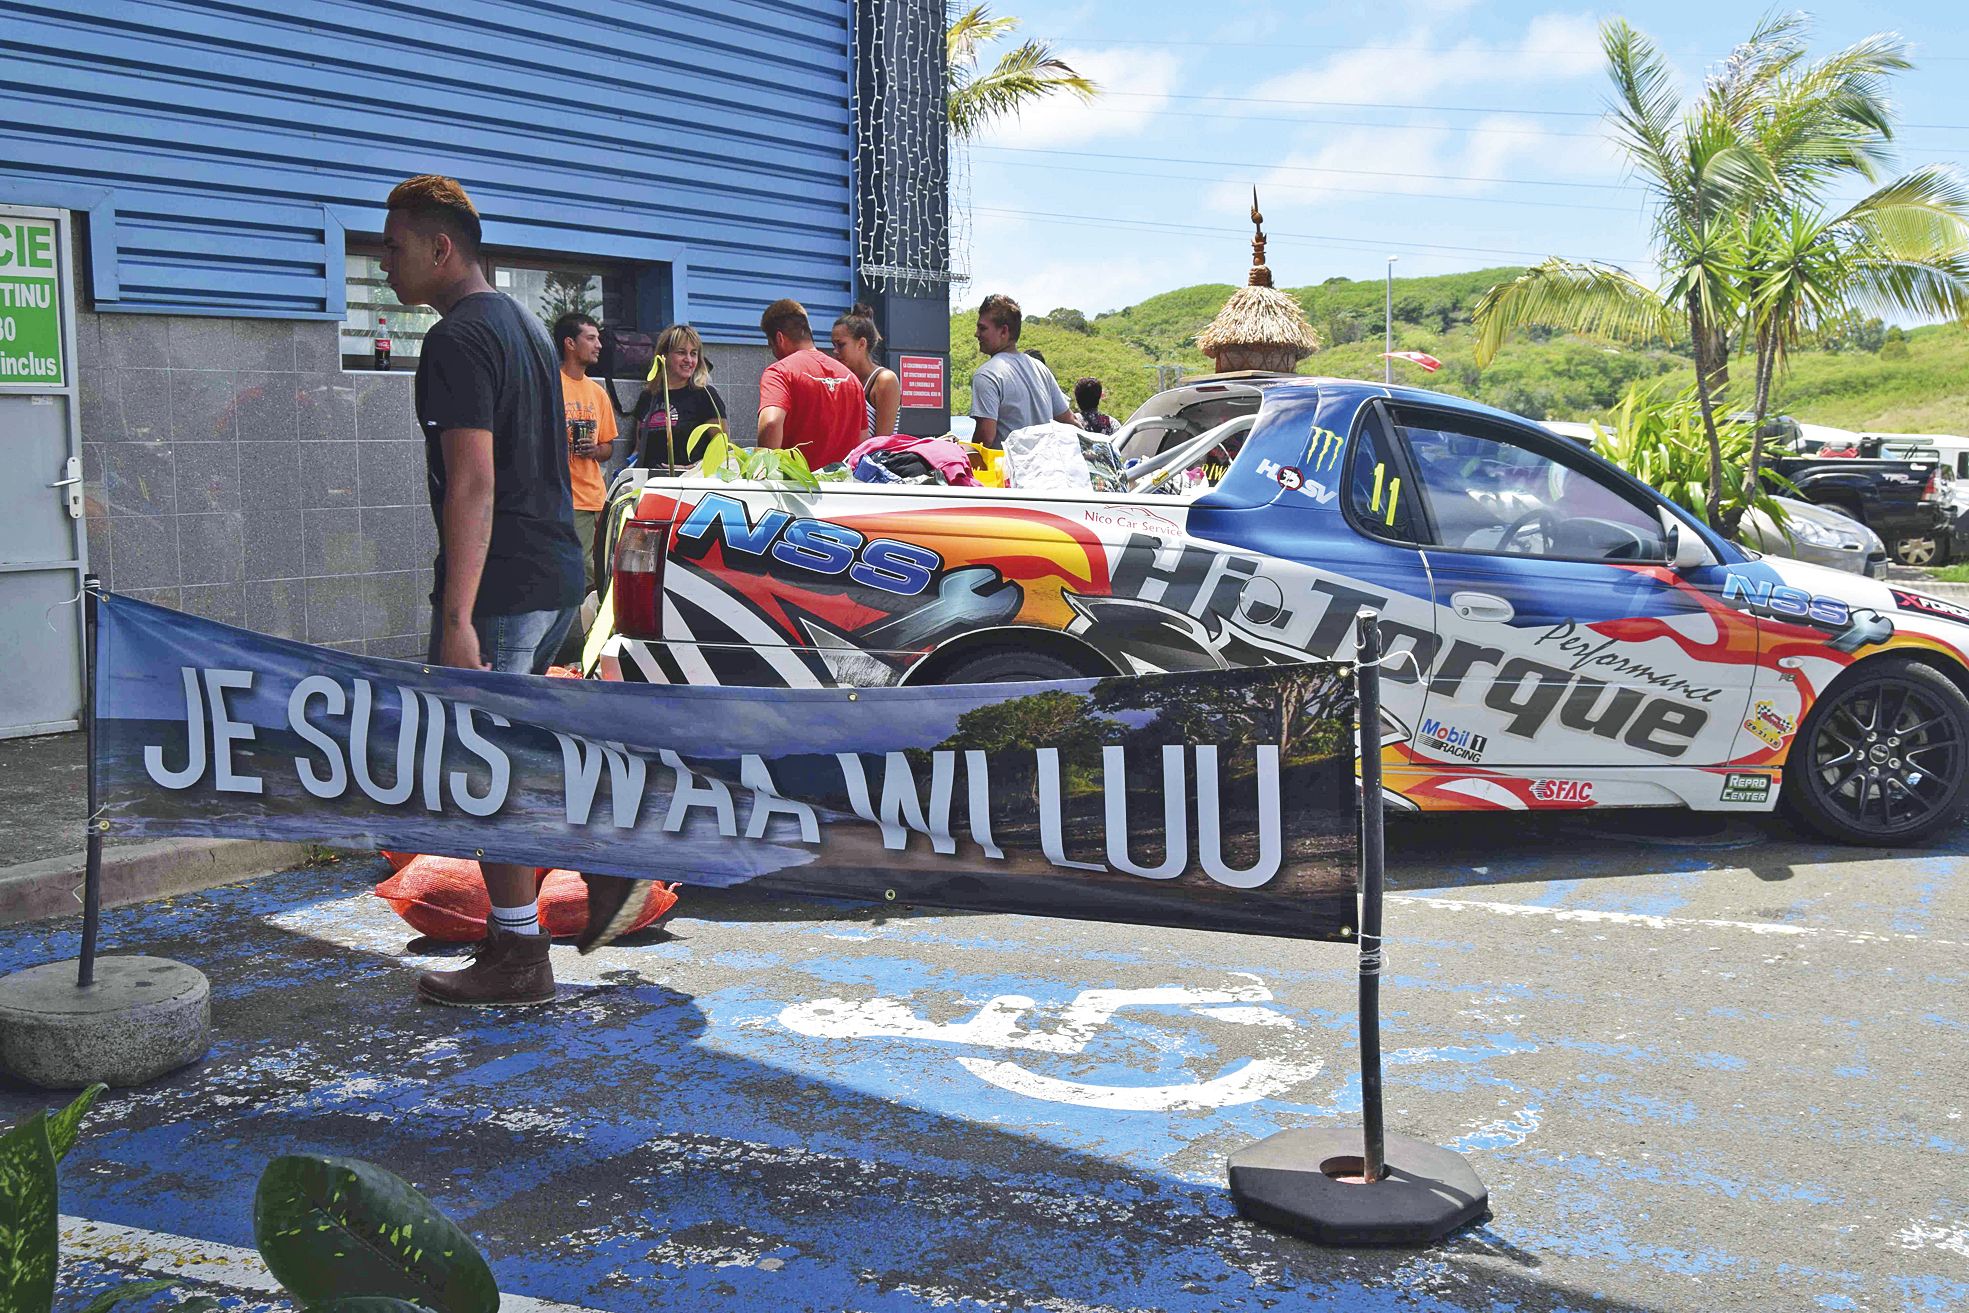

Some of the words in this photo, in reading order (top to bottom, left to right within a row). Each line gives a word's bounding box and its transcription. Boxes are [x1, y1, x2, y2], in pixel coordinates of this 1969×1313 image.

[1, 351, 57, 376] inclus
[1371, 463, 1400, 526] 11
[1085, 510, 1112, 525] Nico
[1116, 517, 1138, 529] Car
[1142, 521, 1183, 537] Service
[678, 492, 941, 595] NSS
[1721, 573, 1849, 626] NSS
[1533, 618, 1722, 703] Performance
[1421, 719, 1470, 747] Mobil
[1440, 741, 1482, 763] RACING
[144, 666, 263, 795] JE
[287, 674, 512, 818] SUIS
[835, 749, 1004, 860] WI
[1036, 744, 1282, 889] LUU
[1543, 780, 1593, 801] SFAC
[1722, 789, 1767, 801] CENTER
